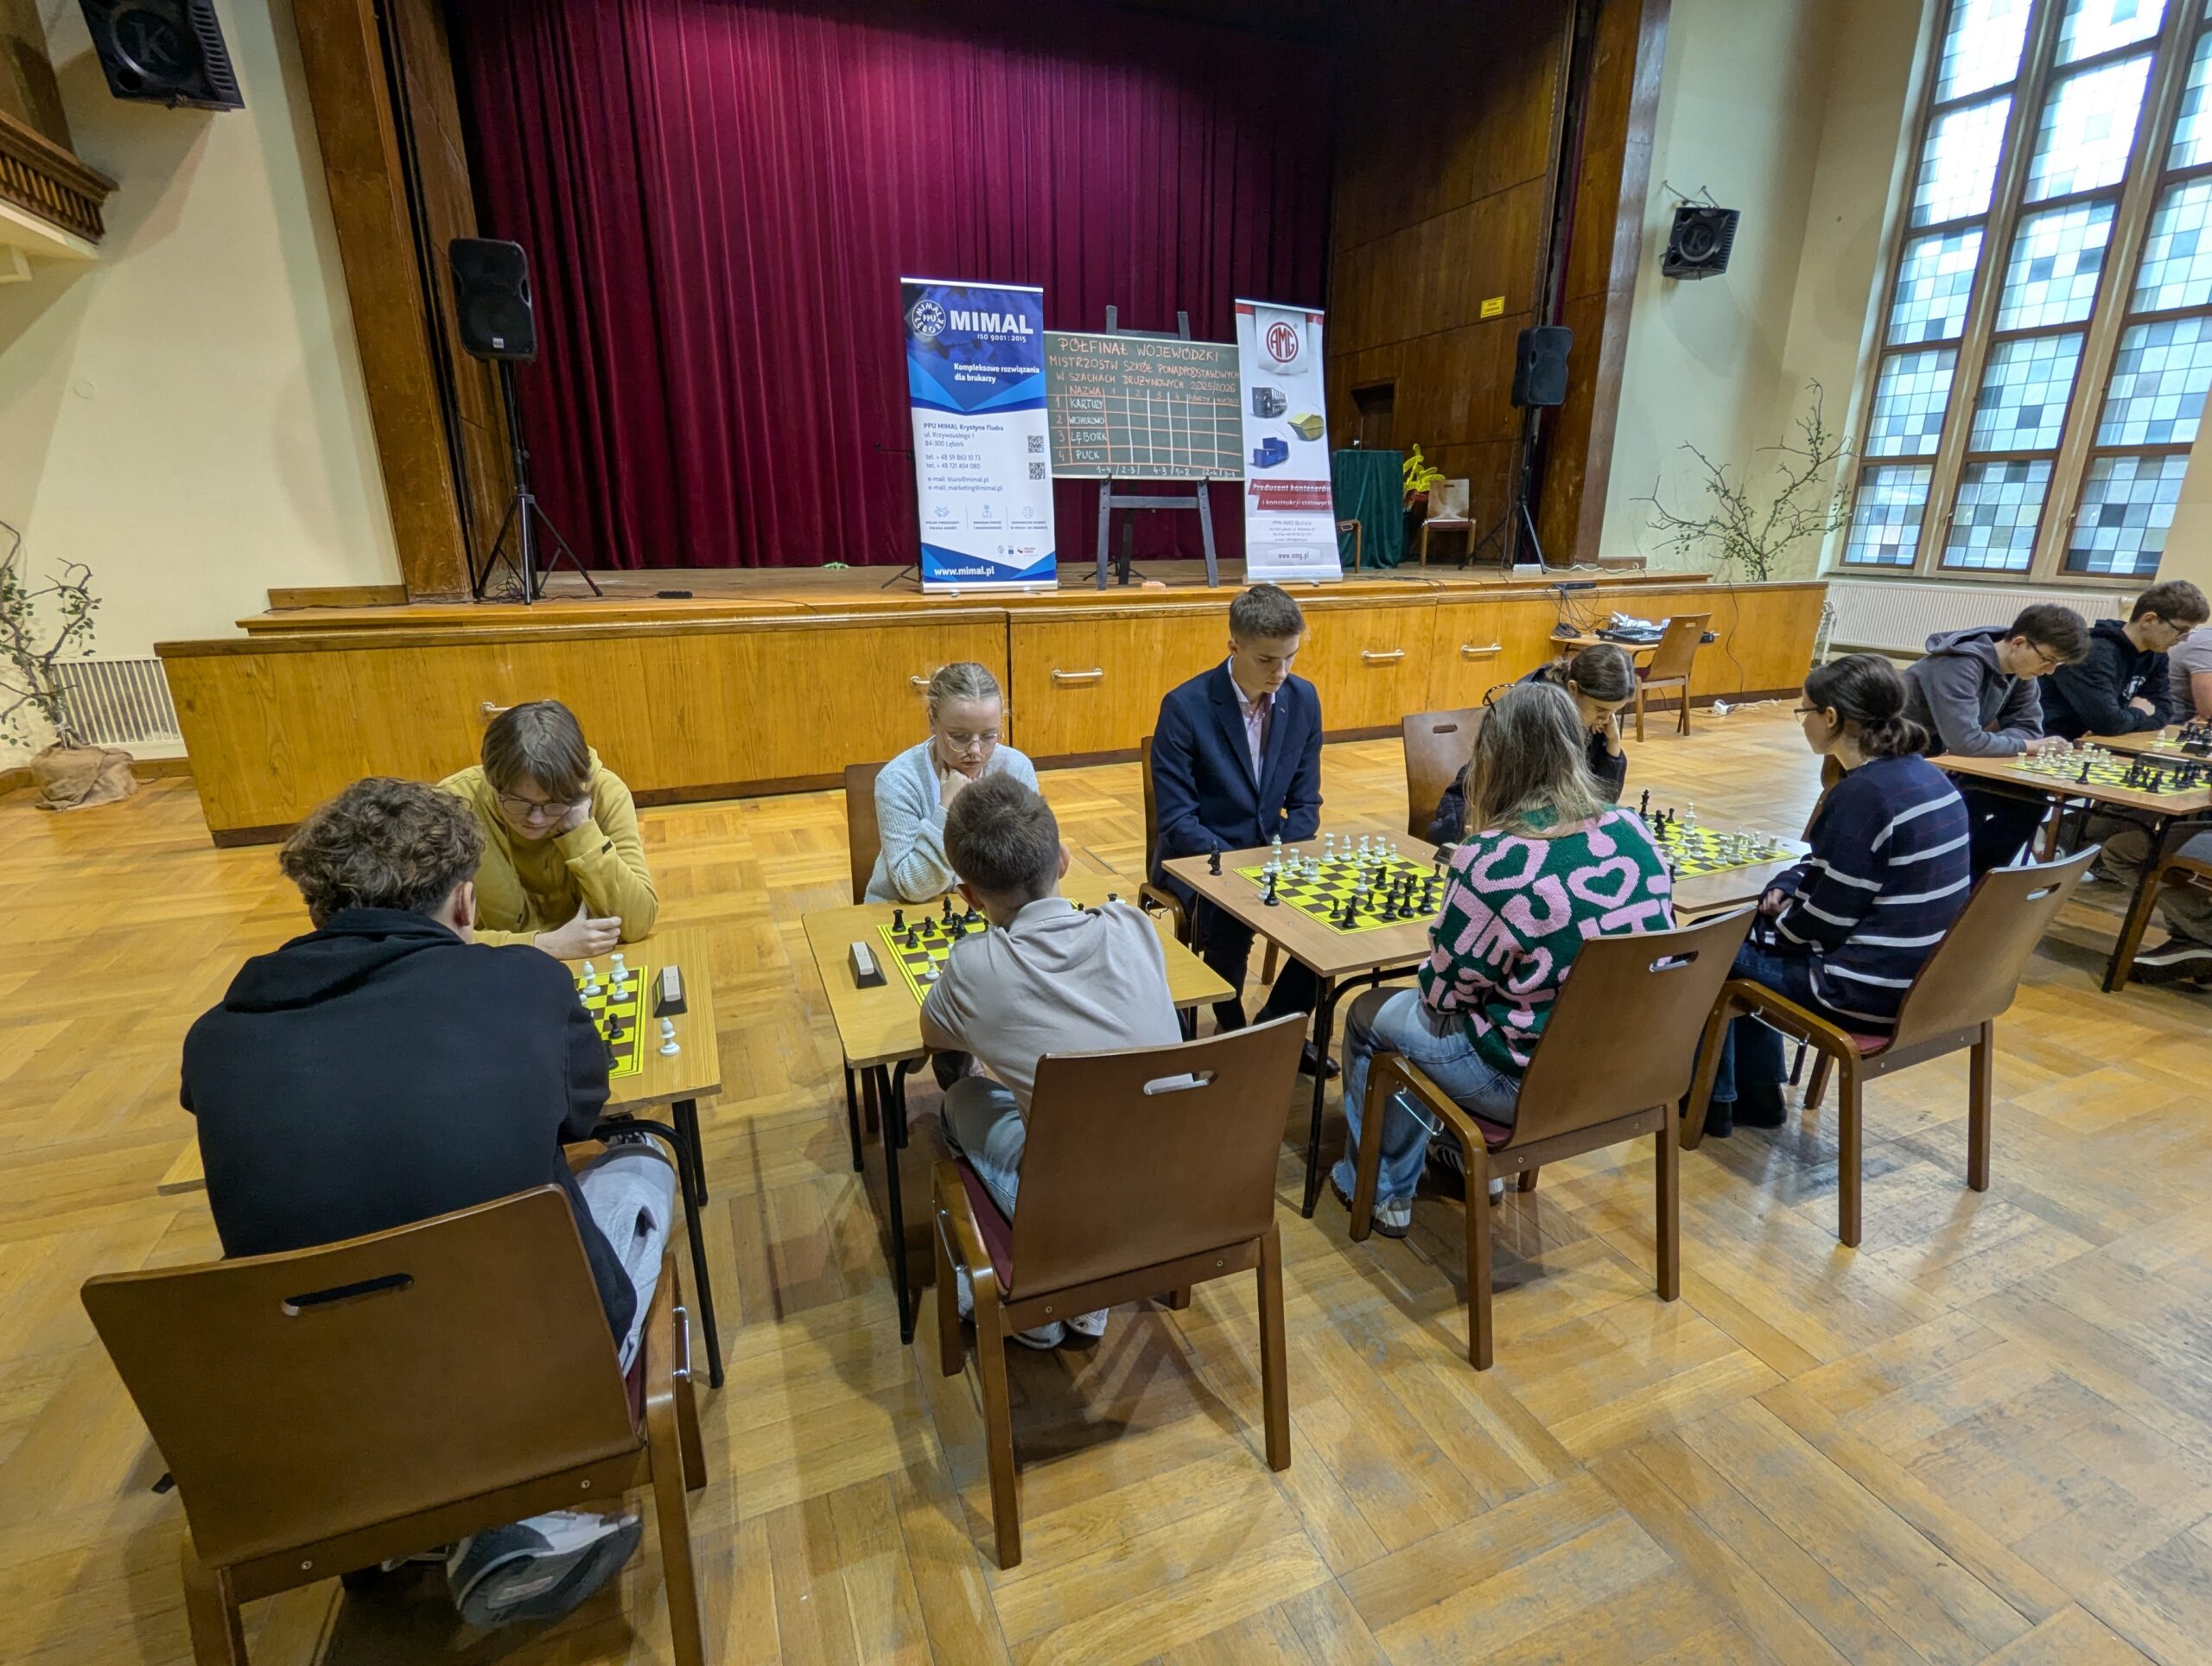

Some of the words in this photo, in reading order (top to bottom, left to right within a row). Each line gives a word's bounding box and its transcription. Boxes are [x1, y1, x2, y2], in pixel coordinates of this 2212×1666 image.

[923, 314, 936, 322] PPU
[950, 310, 1033, 334] MIMAL
[1270, 327, 1296, 359] AMG
[1058, 337, 1128, 355] PÓŁFINAŁ
[1136, 345, 1218, 361] WOJEWÓDZKI
[1049, 355, 1118, 370] MISTRZOSTW
[954, 363, 1000, 373] Kompleksowe
[1001, 366, 1039, 374] rozwiązania
[967, 374, 996, 384] brukarzy
[1069, 373, 1116, 384] SZACHACH
[1070, 385, 1102, 396] NAZWA
[1070, 397, 1103, 410] KARTUZY
[1056, 416, 1064, 424] 2
[1058, 430, 1065, 442] 3
[1076, 449, 1100, 460] PUCK
[1252, 483, 1288, 492] Producent
[1278, 550, 1309, 561] www.amg.pl
[934, 566, 995, 577] www.mimal.pl
